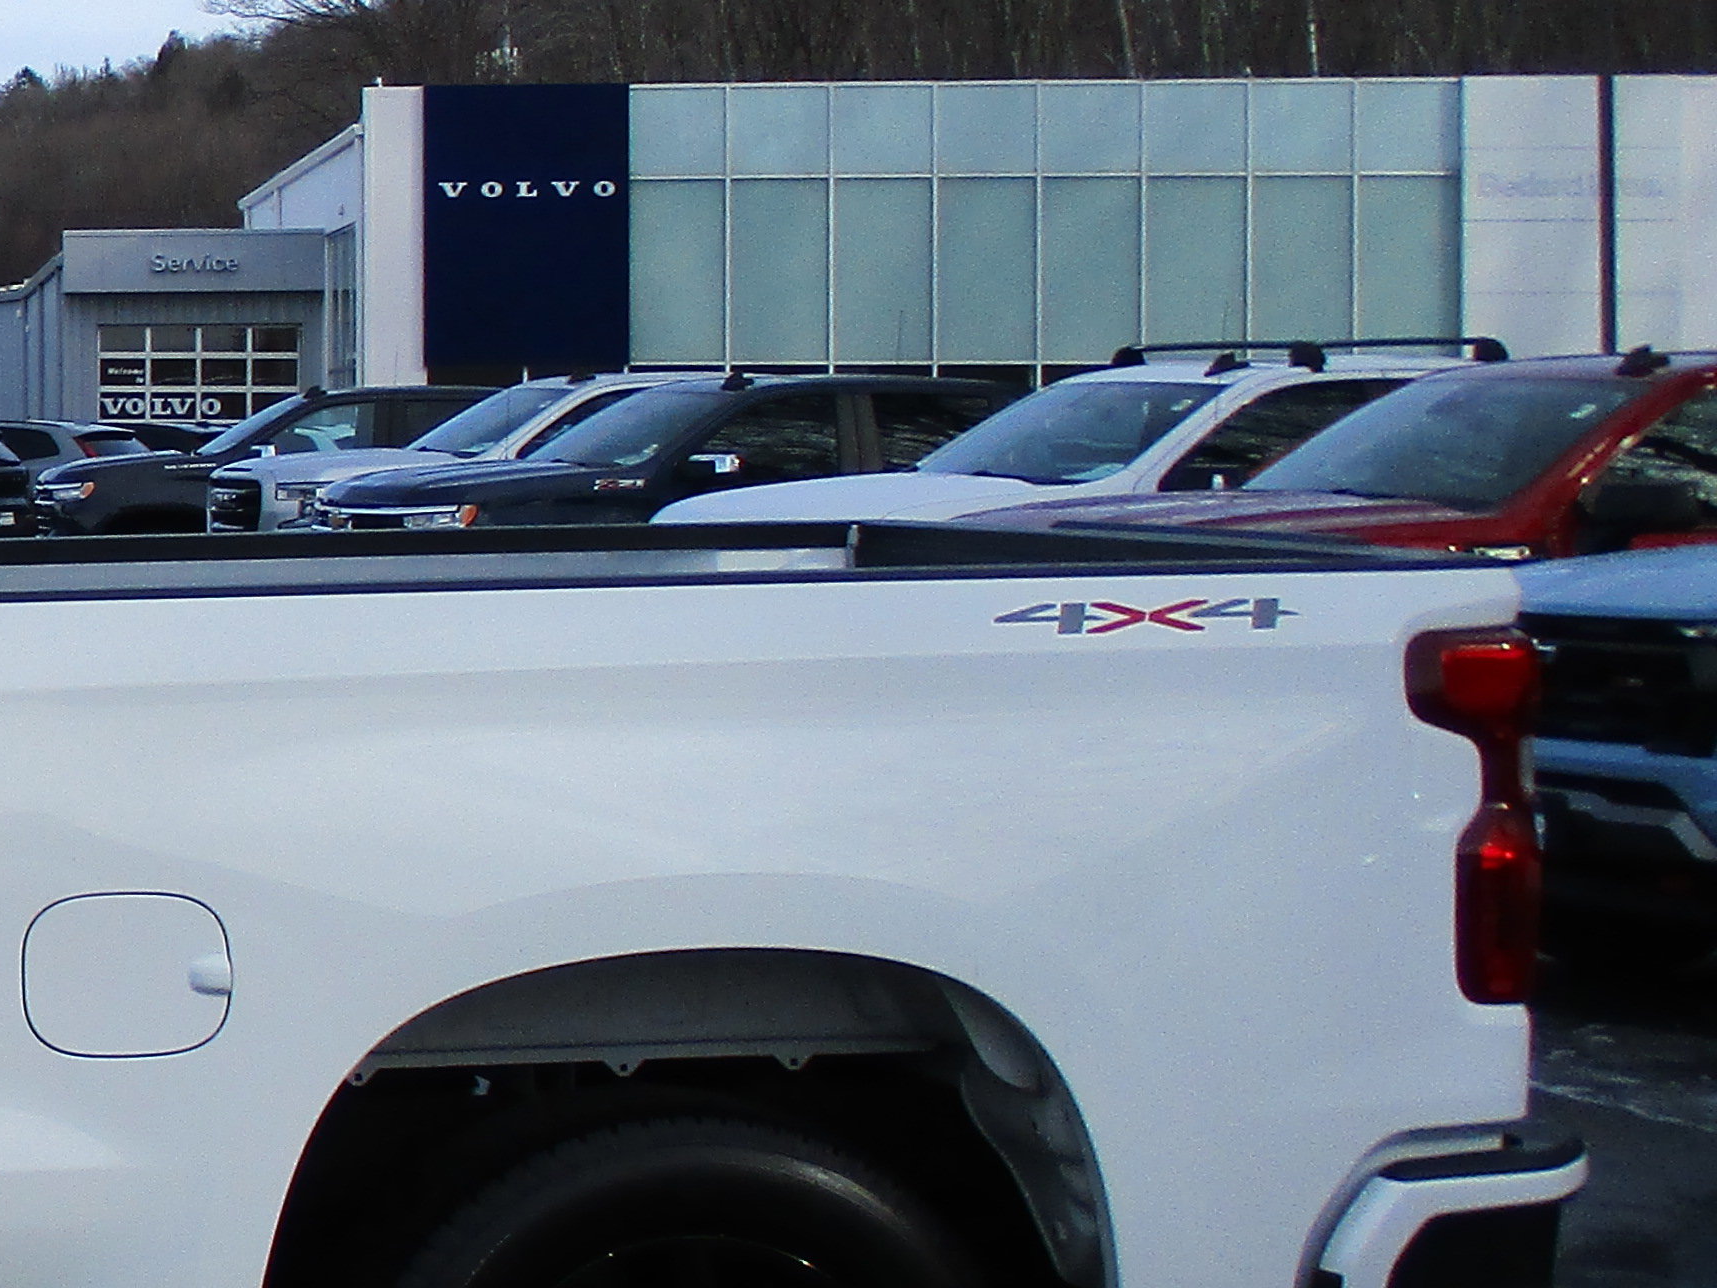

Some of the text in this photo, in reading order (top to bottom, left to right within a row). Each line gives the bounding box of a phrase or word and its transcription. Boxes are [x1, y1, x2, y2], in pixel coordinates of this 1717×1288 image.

[437, 179, 617, 199] VOLVO
[149, 253, 240, 273] Service
[99, 396, 222, 416] VOLVO
